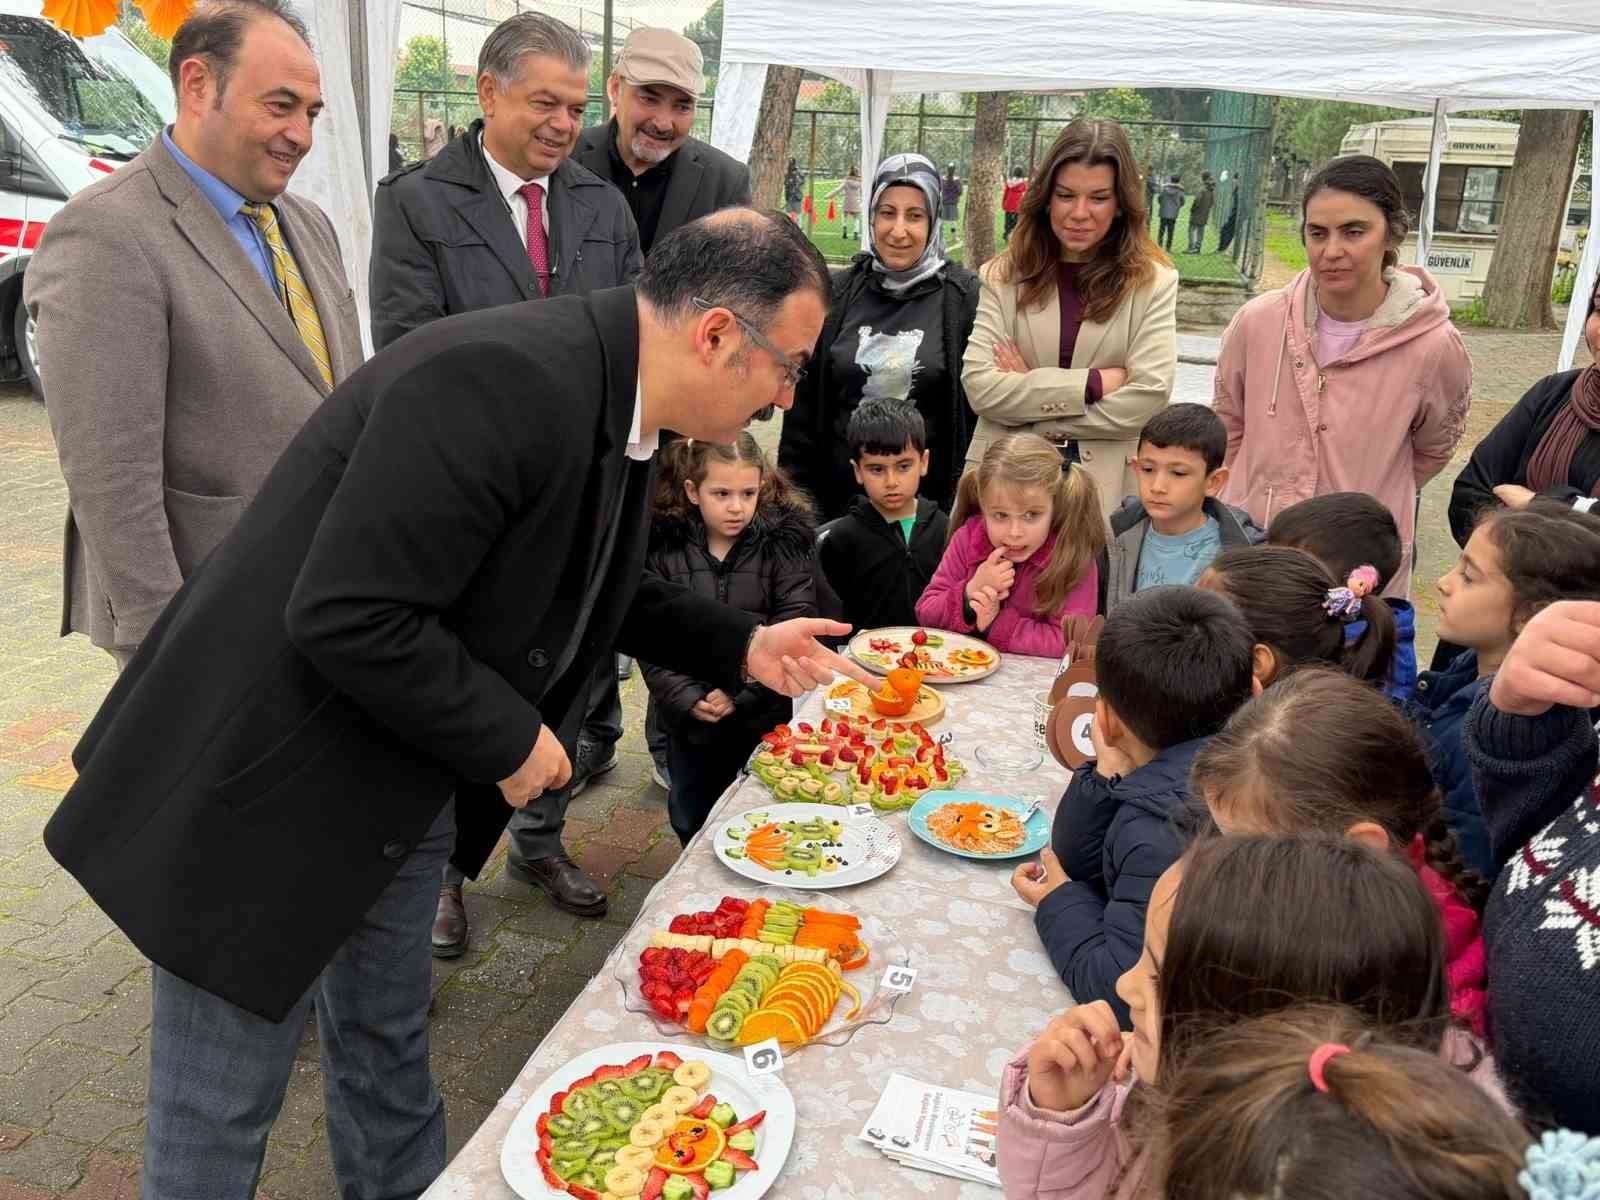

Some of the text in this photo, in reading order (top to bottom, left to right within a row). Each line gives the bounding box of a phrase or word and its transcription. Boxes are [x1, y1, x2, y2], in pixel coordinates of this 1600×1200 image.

[1427, 255, 1471, 268] GÜVENLİK
[889, 971, 913, 987] 5
[752, 1048, 778, 1069] 6
